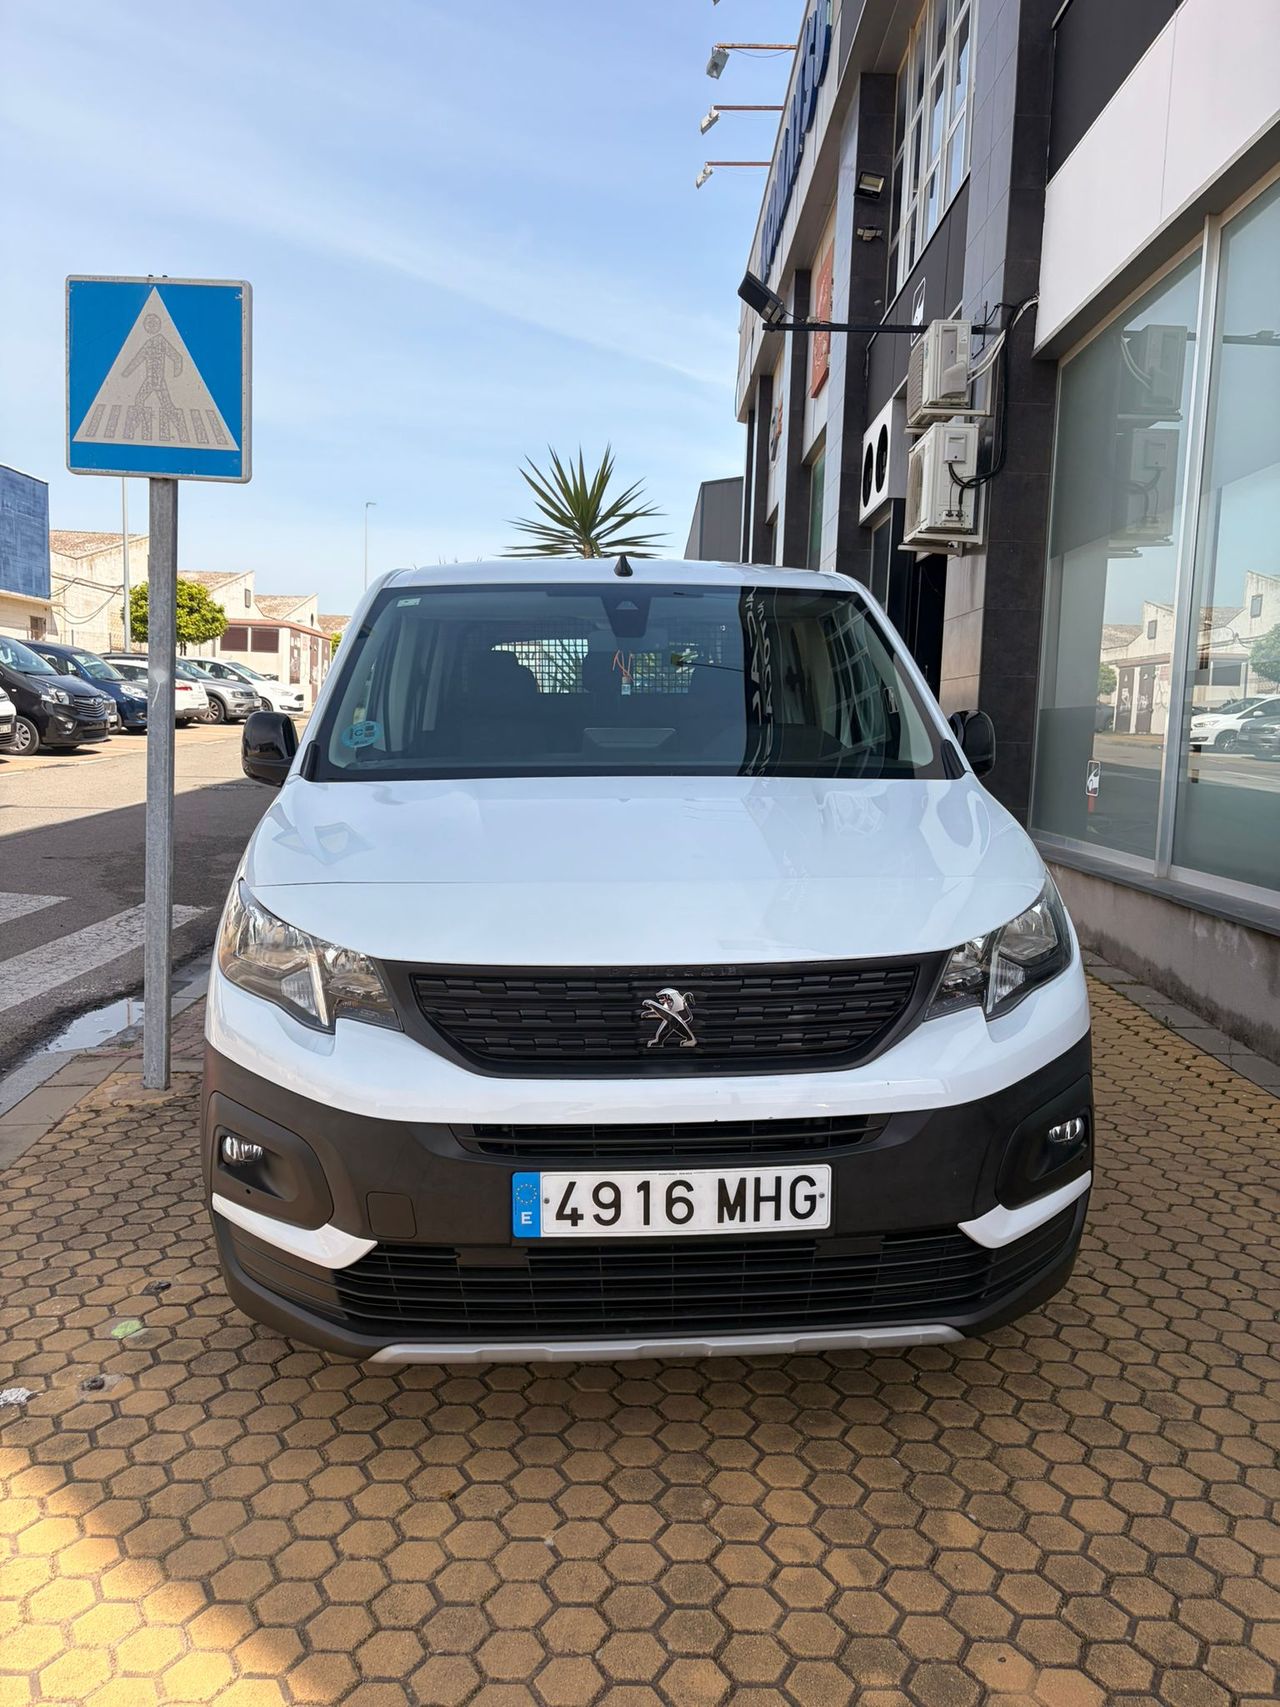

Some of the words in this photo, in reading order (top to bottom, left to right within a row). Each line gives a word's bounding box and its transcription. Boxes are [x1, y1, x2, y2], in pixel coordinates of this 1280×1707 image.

[555, 1179, 695, 1227] 4916
[717, 1174, 817, 1224] MHG
[521, 1211, 533, 1225] E
